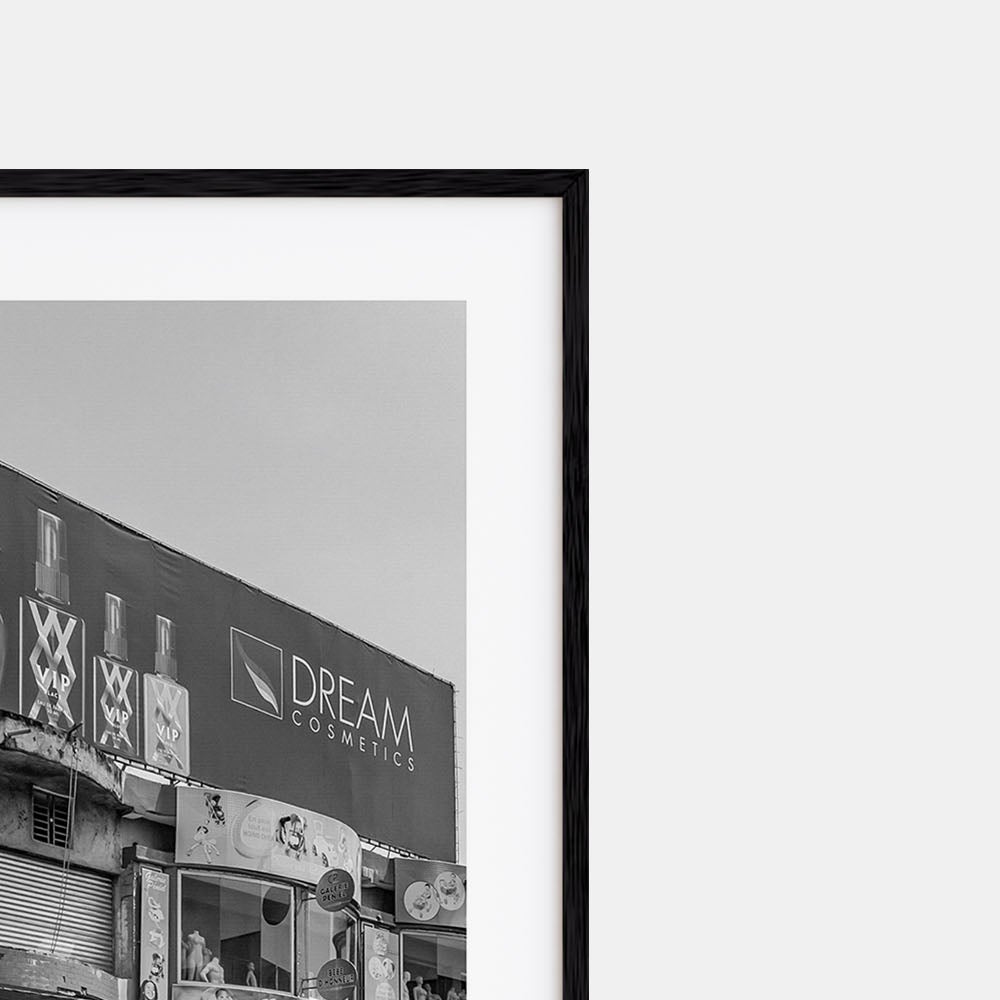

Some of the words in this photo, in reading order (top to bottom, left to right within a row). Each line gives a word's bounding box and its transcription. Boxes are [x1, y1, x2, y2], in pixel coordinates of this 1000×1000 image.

[35, 663, 71, 693] VIP
[104, 703, 130, 724] VIP
[292, 654, 414, 753] DREAM
[155, 722, 180, 742] VIP
[291, 709, 416, 773] COSMETICS
